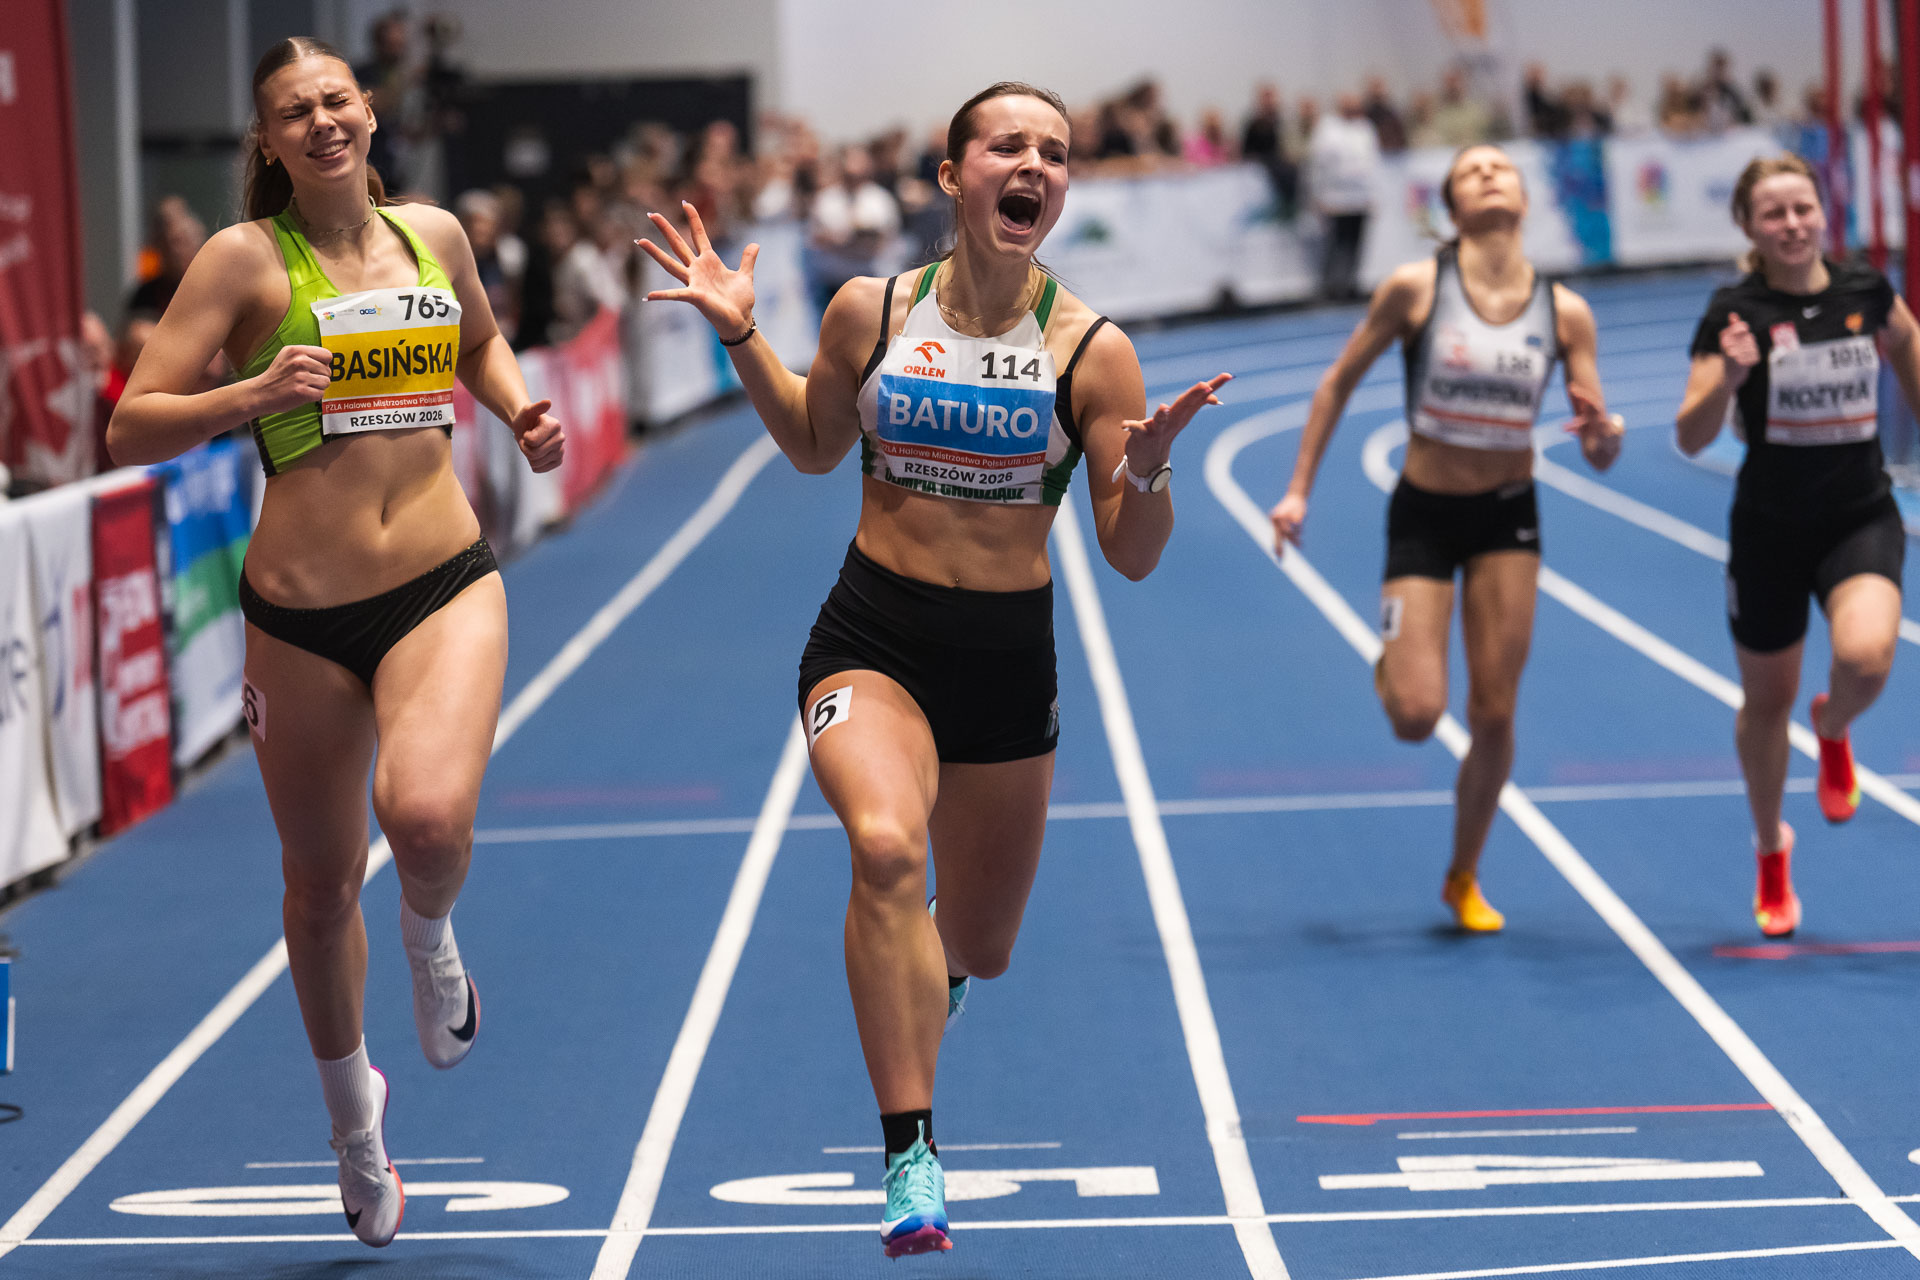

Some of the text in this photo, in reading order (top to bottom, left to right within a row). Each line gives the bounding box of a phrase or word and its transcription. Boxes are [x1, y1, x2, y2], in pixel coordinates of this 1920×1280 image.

[398, 294, 449, 320] 765
[330, 339, 452, 382] BASIŃSKA
[903, 365, 946, 378] ORLEN
[981, 351, 1042, 382] 114
[325, 403, 342, 412] PZLA
[343, 402, 372, 410] Halowe
[373, 398, 418, 408] Mistrzostwa
[889, 392, 1039, 439] BATURO
[350, 410, 442, 427] RZESZÓW 2026
[899, 447, 931, 457] Halowe
[932, 451, 981, 465] Mistrzostwa
[982, 457, 1006, 467] Polski
[904, 462, 1013, 485] RZESZÓW 2026
[244, 683, 259, 727] 6
[813, 692, 838, 735] 5
